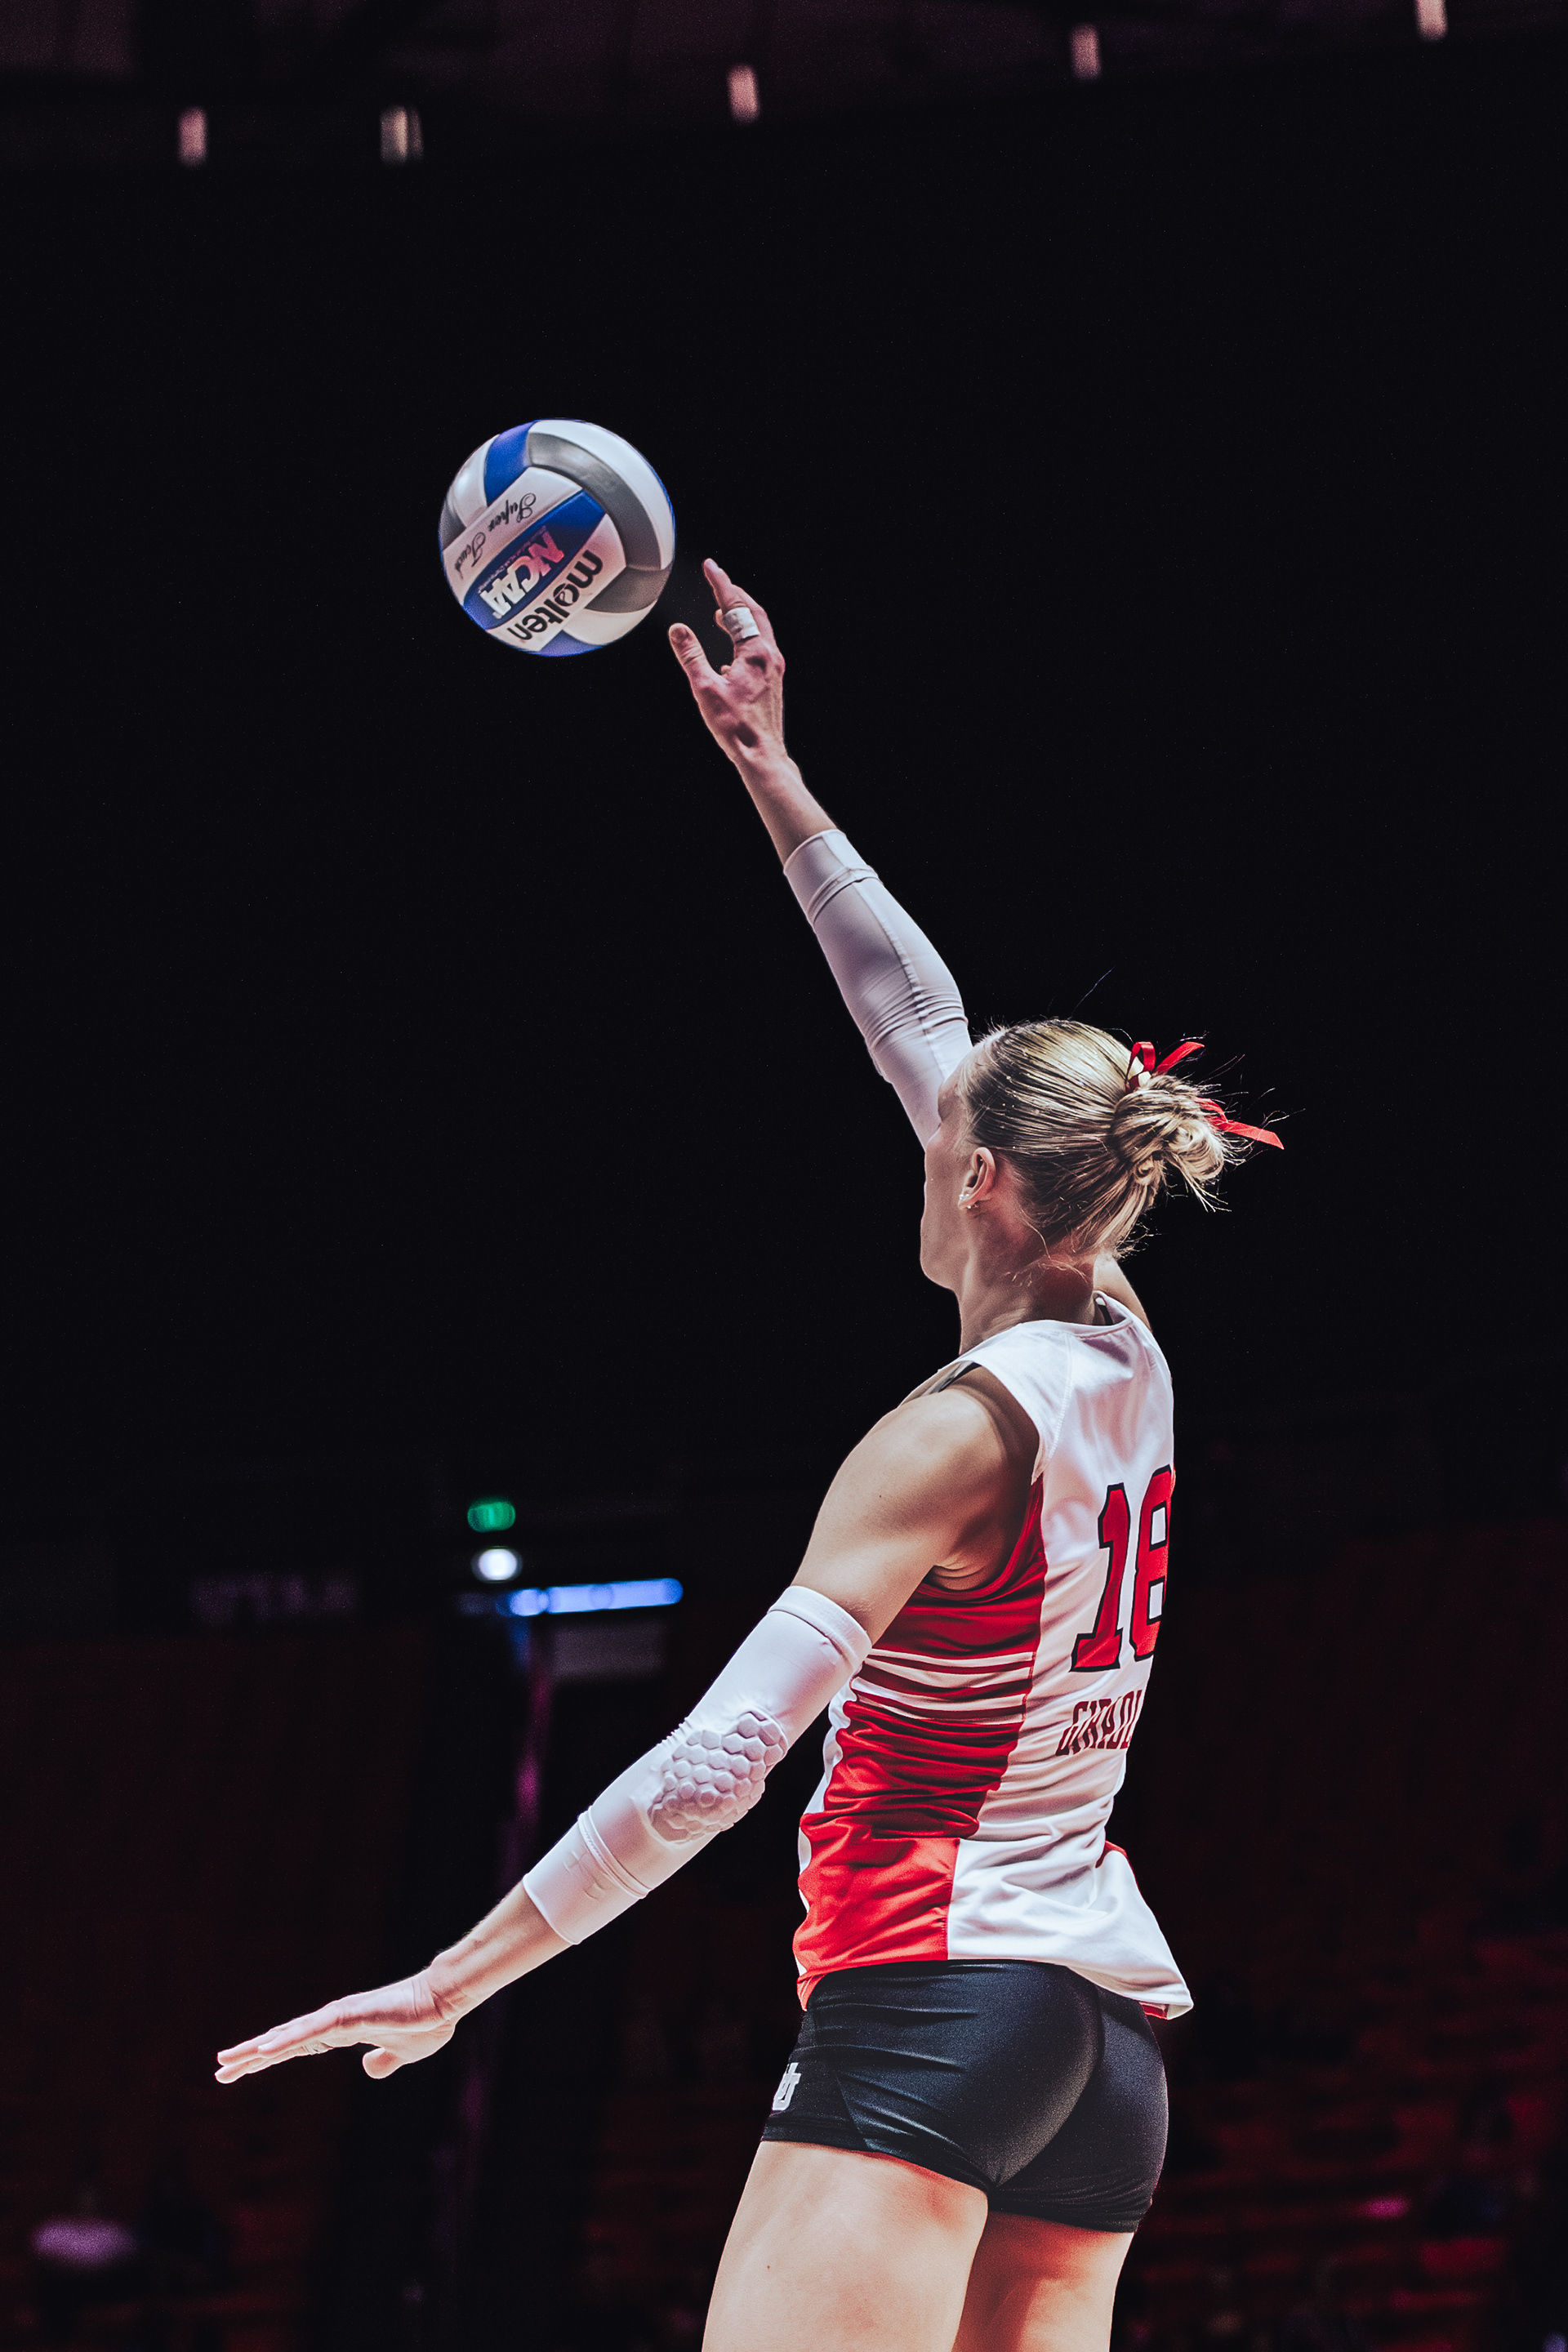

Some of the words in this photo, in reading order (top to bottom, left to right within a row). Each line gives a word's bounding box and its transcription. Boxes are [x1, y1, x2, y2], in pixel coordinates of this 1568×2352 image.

[488, 493, 537, 532] Super
[479, 530, 564, 619] NCAA
[506, 550, 603, 640] molten
[1069, 1464, 1176, 1673] 18
